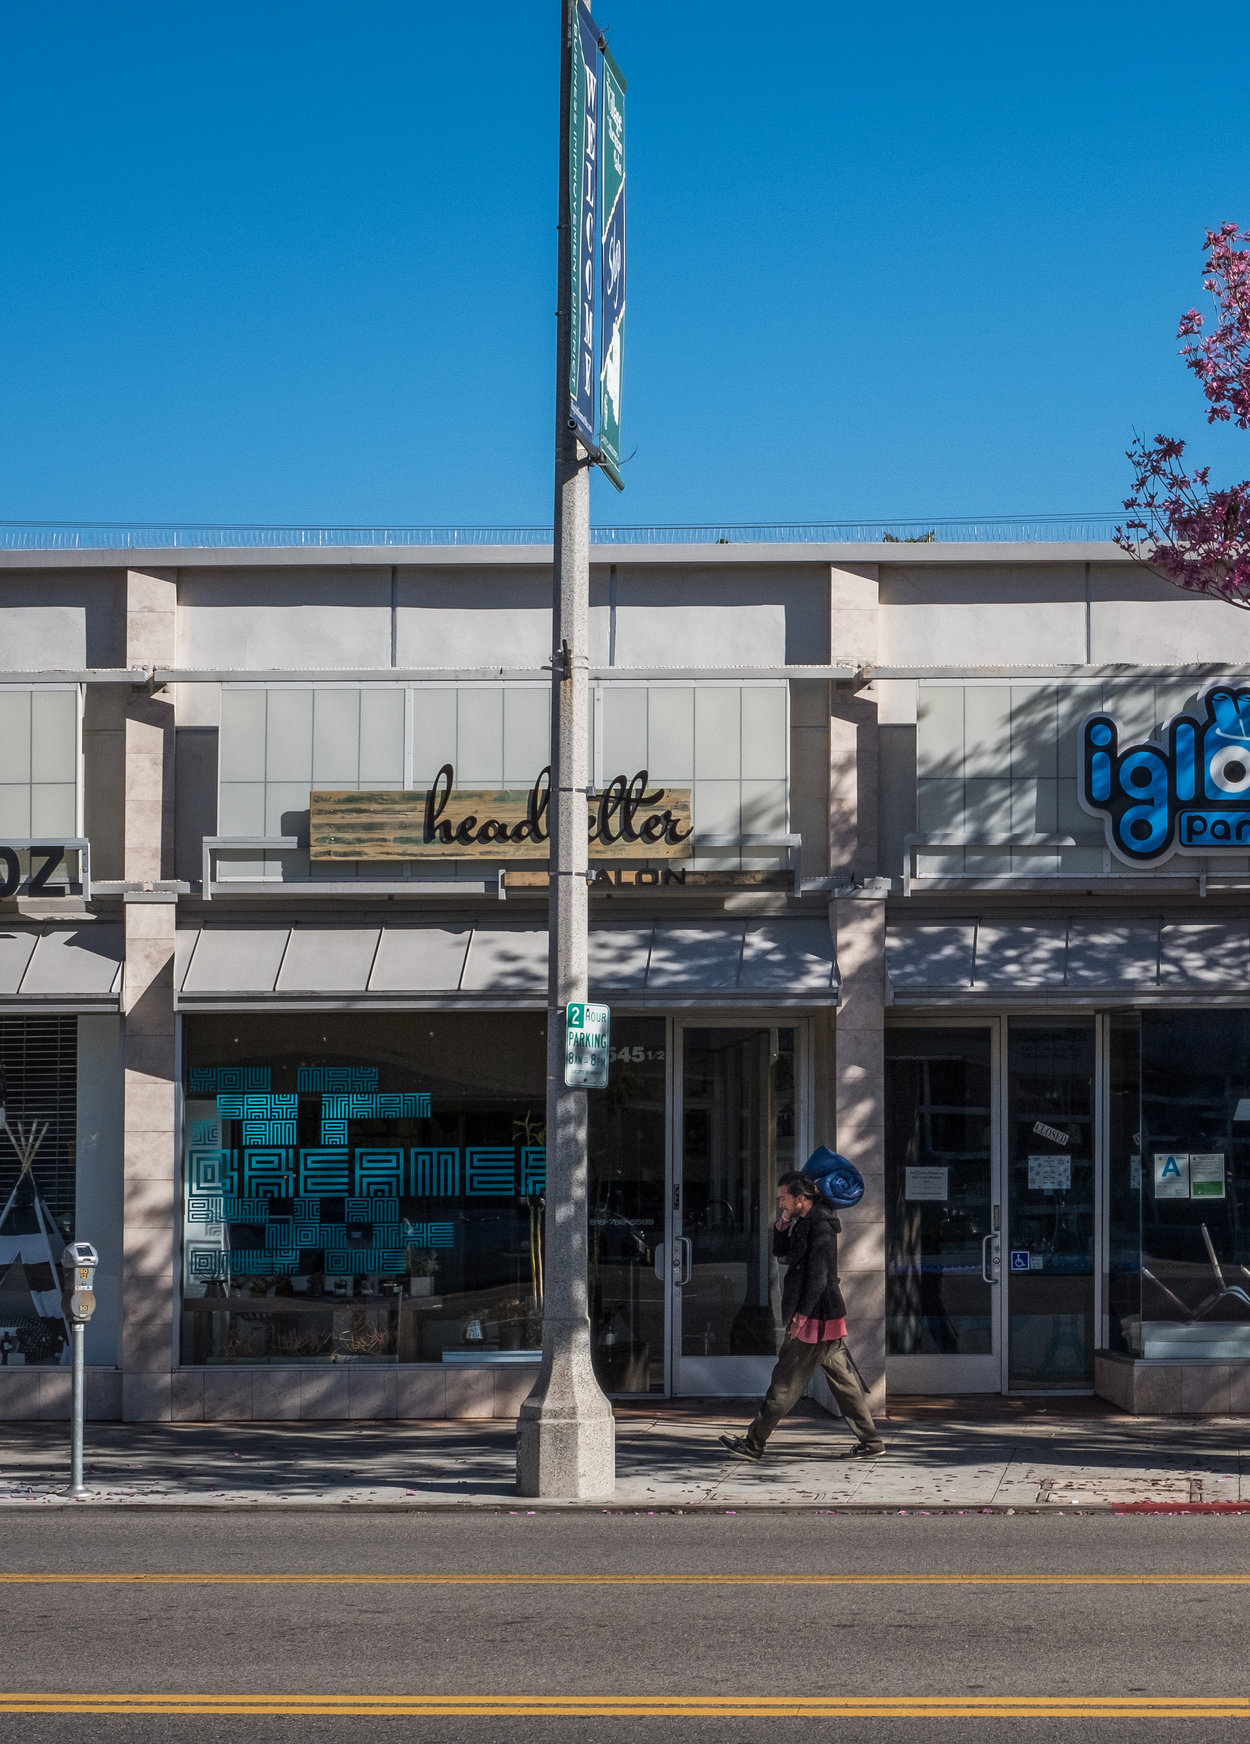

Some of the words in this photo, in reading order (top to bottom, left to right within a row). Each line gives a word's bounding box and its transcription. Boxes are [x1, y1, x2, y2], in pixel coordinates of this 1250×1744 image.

[584, 64, 597, 397] WELCOME
[591, 867, 686, 886] ALON
[571, 1006, 580, 1025] 2
[585, 1011, 607, 1024] HOUR
[568, 1031, 607, 1049] PARKING
[189, 1067, 271, 1092] YOU
[297, 1067, 379, 1092] MAY
[216, 1094, 298, 1119] SAY
[321, 1093, 431, 1118] THAT
[242, 1120, 296, 1145] AM
[320, 1119, 348, 1145] A
[1161, 1156, 1181, 1177] A
[188, 1197, 270, 1223] BUT
[345, 1197, 399, 1223] AM
[265, 1223, 348, 1249] NOT
[372, 1222, 454, 1249] THE
[190, 1249, 300, 1275] ONLY
[324, 1249, 406, 1275] ONE
